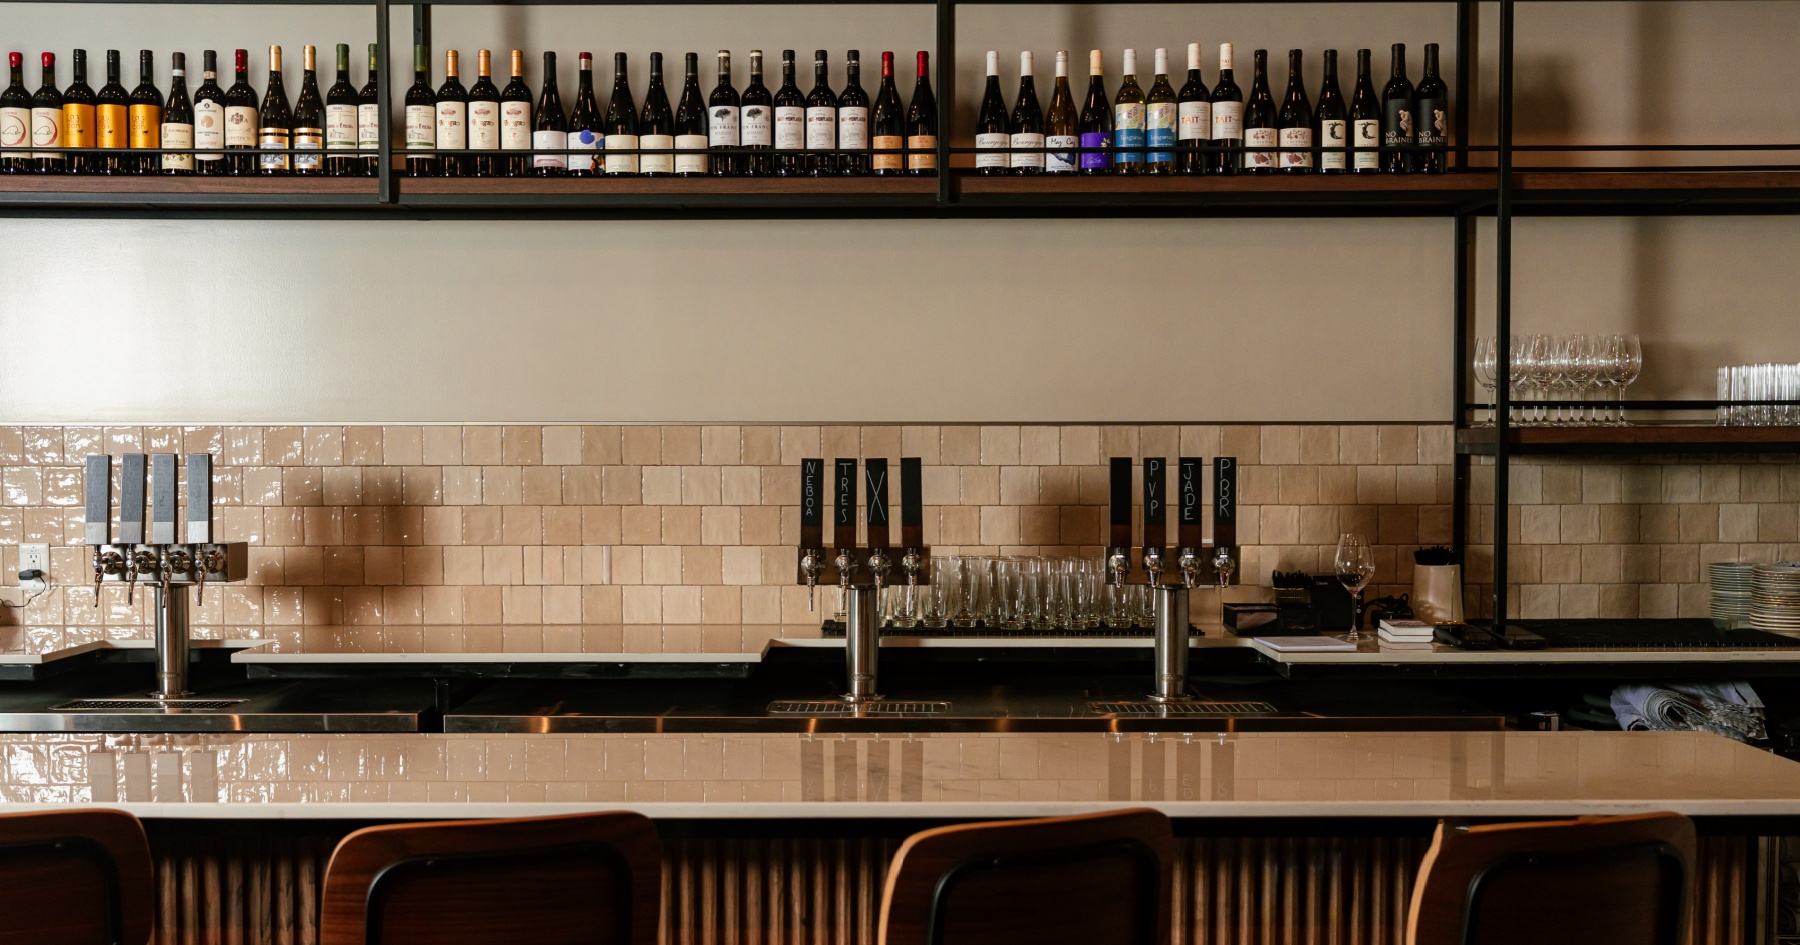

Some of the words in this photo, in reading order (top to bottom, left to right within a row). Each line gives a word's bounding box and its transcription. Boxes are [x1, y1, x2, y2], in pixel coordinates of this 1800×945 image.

[1181, 116, 1199, 124] TAIT
[805, 461, 816, 516] NEBOA
[839, 462, 853, 523] TRES
[1148, 460, 1159, 517] PVP
[1183, 463, 1196, 520] JADE
[1219, 458, 1231, 517] PBR
